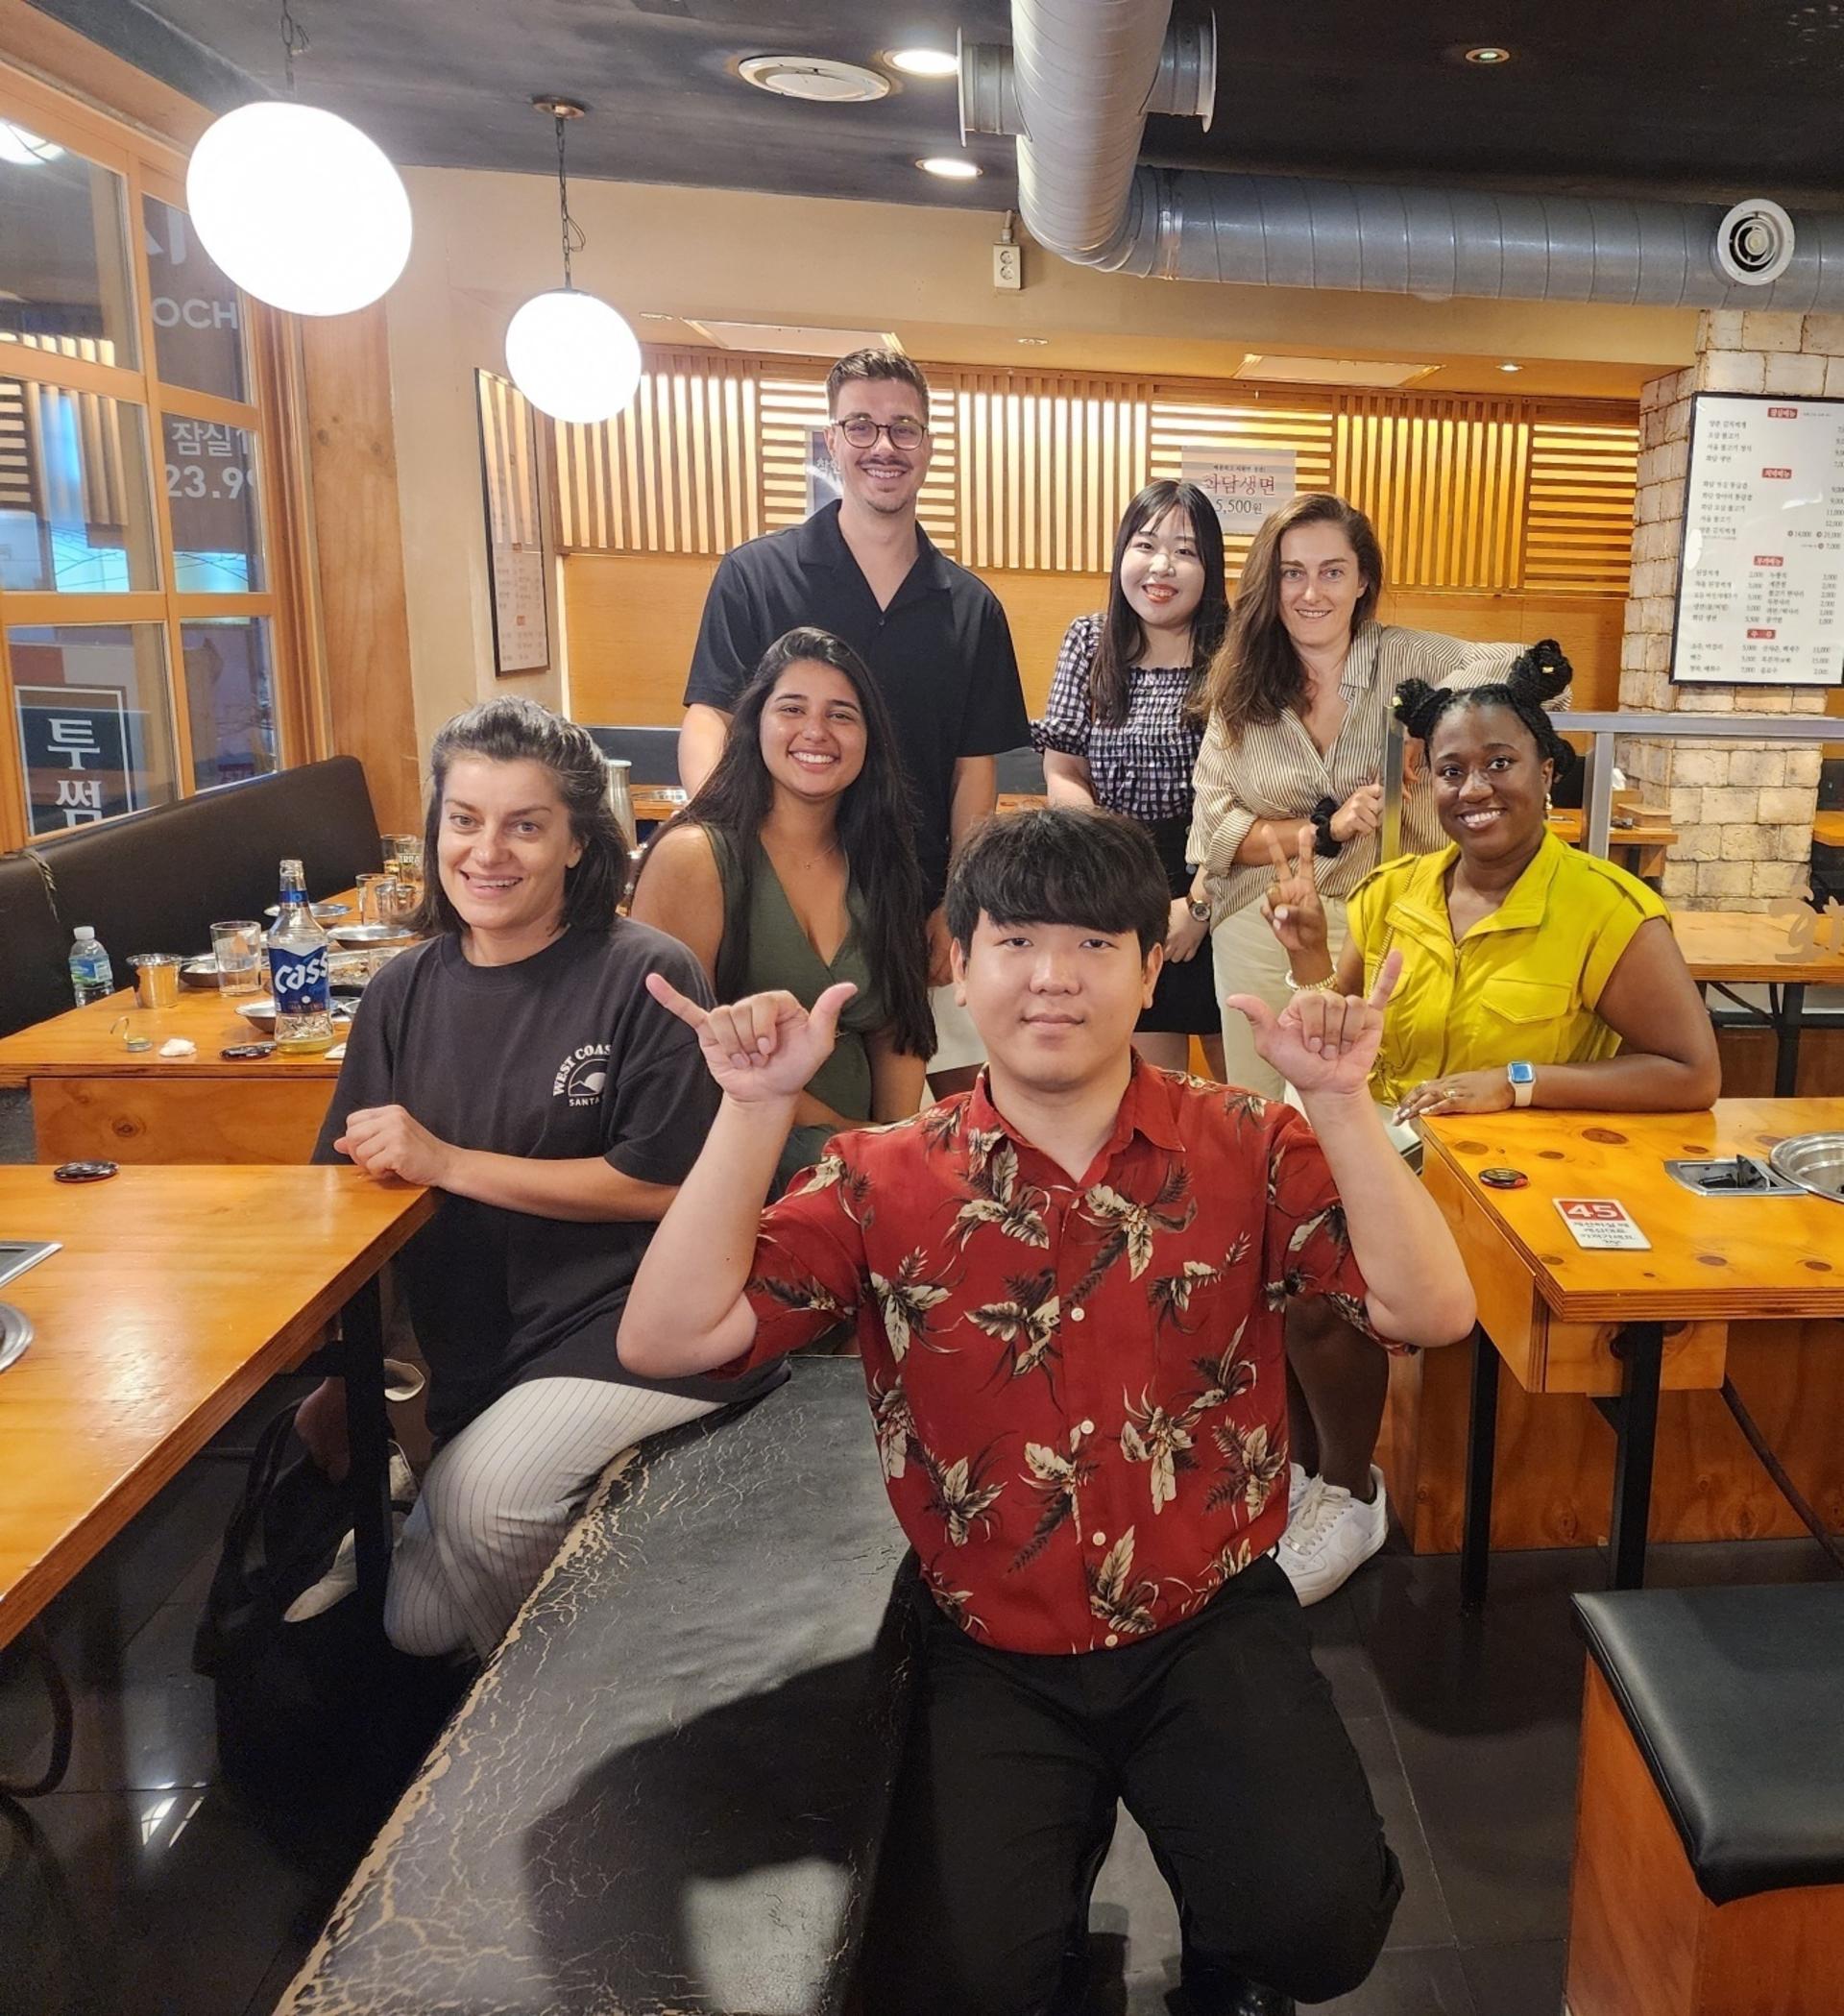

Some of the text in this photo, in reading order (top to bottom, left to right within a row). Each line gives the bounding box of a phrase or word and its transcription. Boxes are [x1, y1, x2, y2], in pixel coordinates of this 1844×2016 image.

[1216, 499, 1262, 515] 5,500원
[553, 1057, 576, 1097] WEST
[569, 1097, 600, 1107] SANTA
[1566, 1203, 1619, 1219] 45
